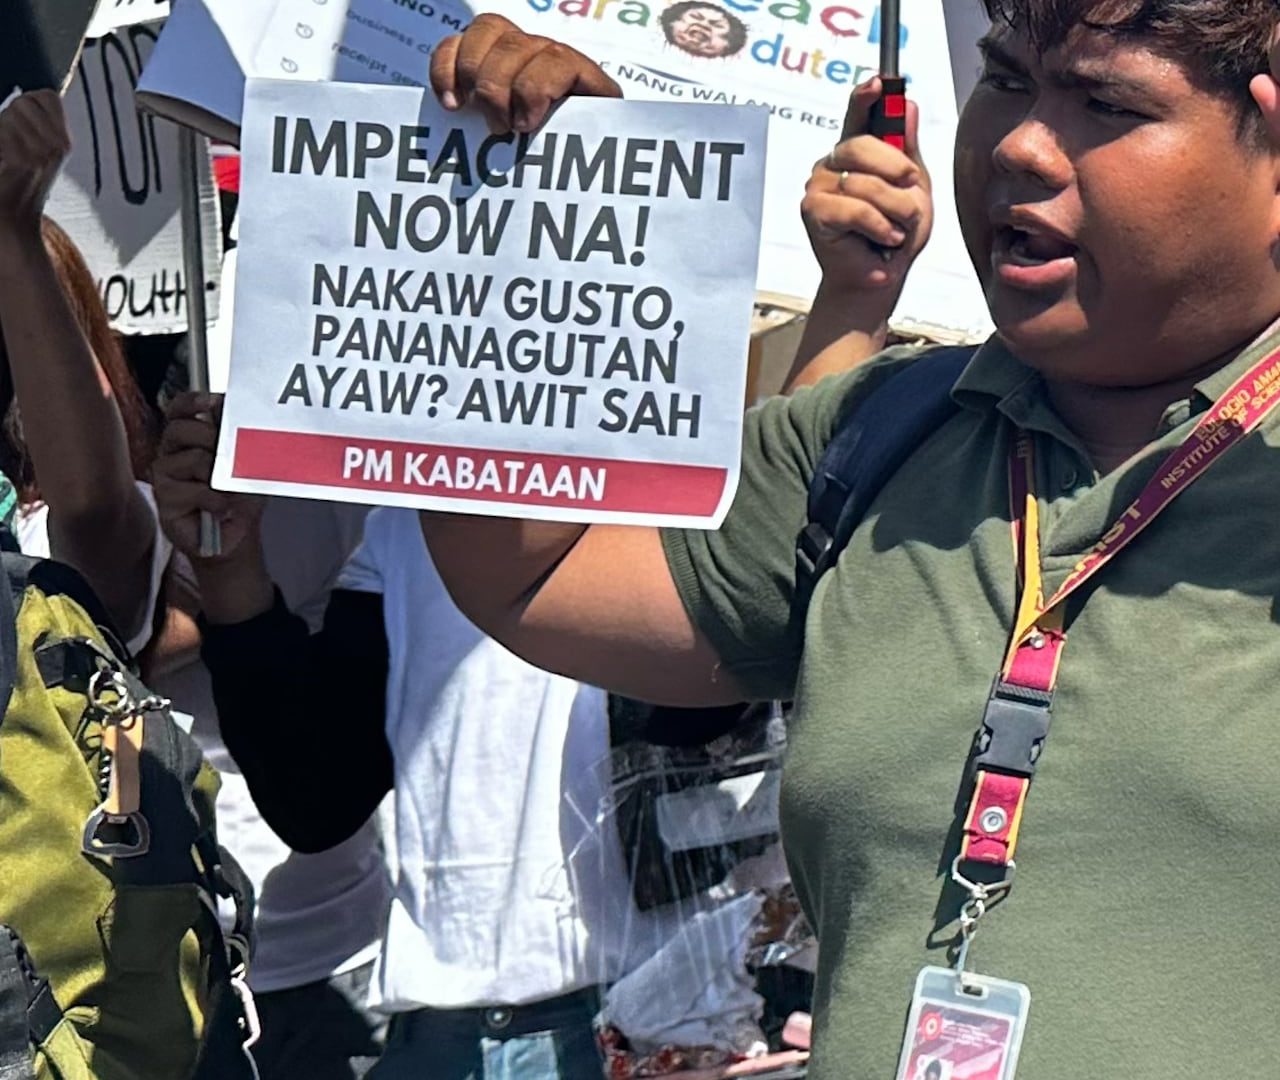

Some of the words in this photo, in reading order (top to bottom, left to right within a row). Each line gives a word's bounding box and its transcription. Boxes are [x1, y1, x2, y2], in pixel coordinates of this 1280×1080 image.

[332, 41, 388, 74] receipt
[345, 9, 414, 47] business
[616, 63, 685, 97] NANG
[272, 115, 745, 202] IMPEACHMENT
[353, 190, 514, 257] NOW
[527, 200, 650, 267] NA!
[312, 263, 494, 318] NAKAW
[503, 276, 685, 340] GUSTO,
[311, 314, 679, 385] PANANAGUTAN
[278, 363, 448, 418] AYAW?
[456, 379, 588, 430] AWIT
[598, 387, 702, 439] SAH
[342, 446, 394, 484] PM
[404, 451, 607, 502] KABATAAN
[1159, 424, 1231, 489] INSTITUTE
[1231, 409, 1250, 428] OF
